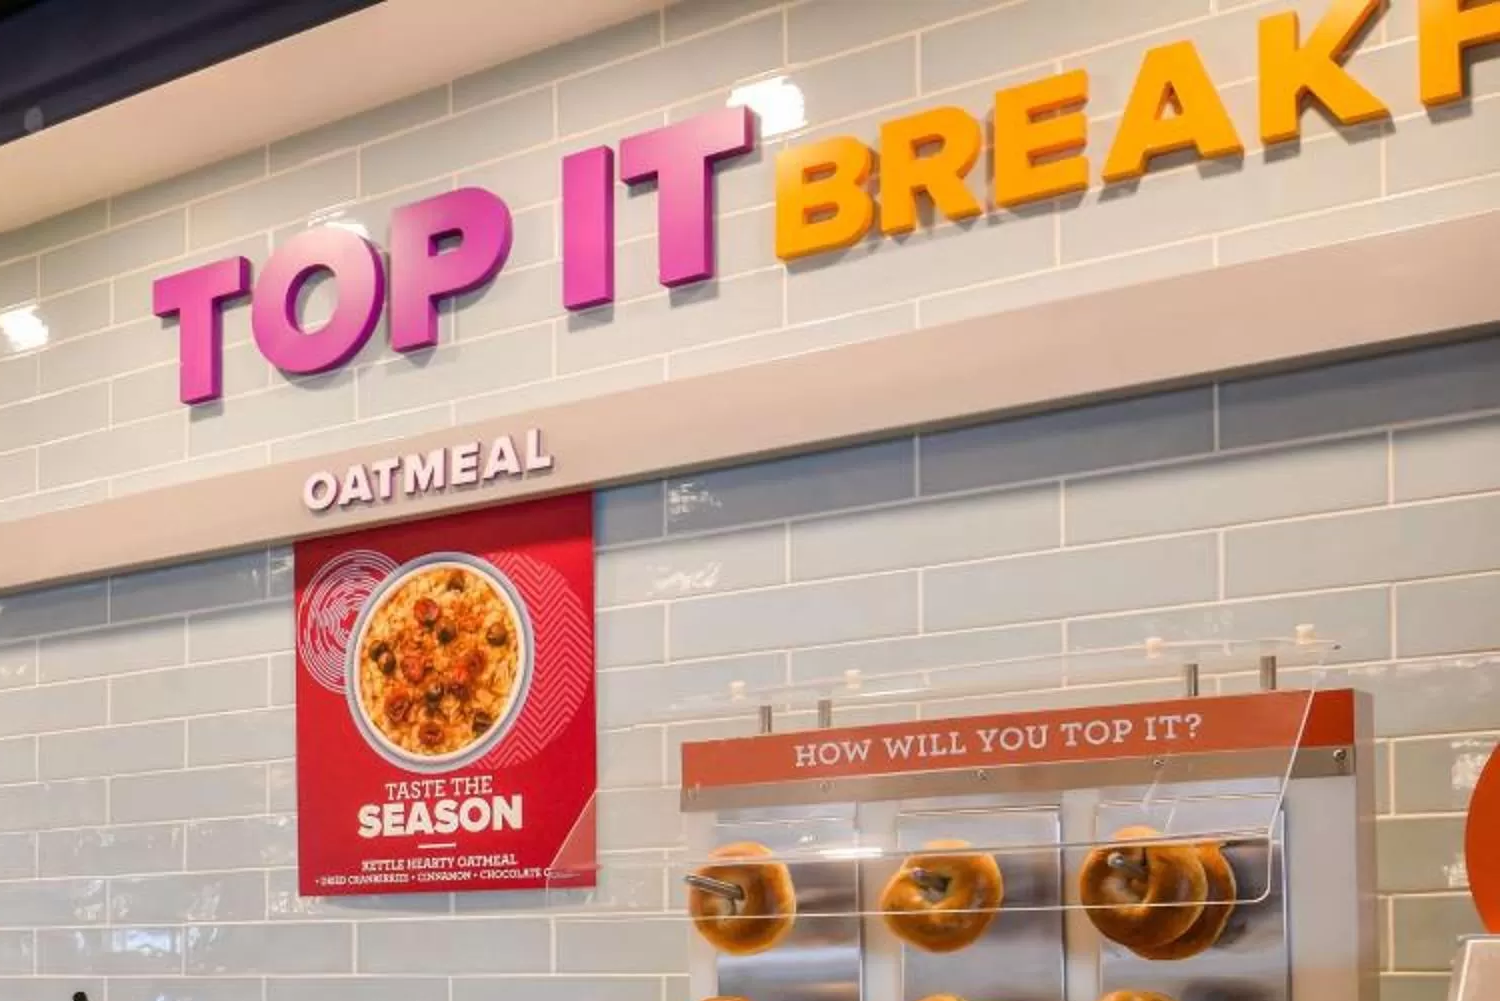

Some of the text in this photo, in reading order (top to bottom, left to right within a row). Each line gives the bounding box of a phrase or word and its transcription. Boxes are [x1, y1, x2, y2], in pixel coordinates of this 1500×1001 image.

[153, 186, 512, 405] TOP
[563, 105, 755, 312] IT
[304, 428, 554, 511] OATMEAL
[795, 712, 1202, 768] HOW WILL YOU TOP IT?
[385, 775, 493, 800] TASTE THE
[357, 794, 523, 838] SEASON
[362, 853, 518, 872] KETTLE HEARTY OATMEAL
